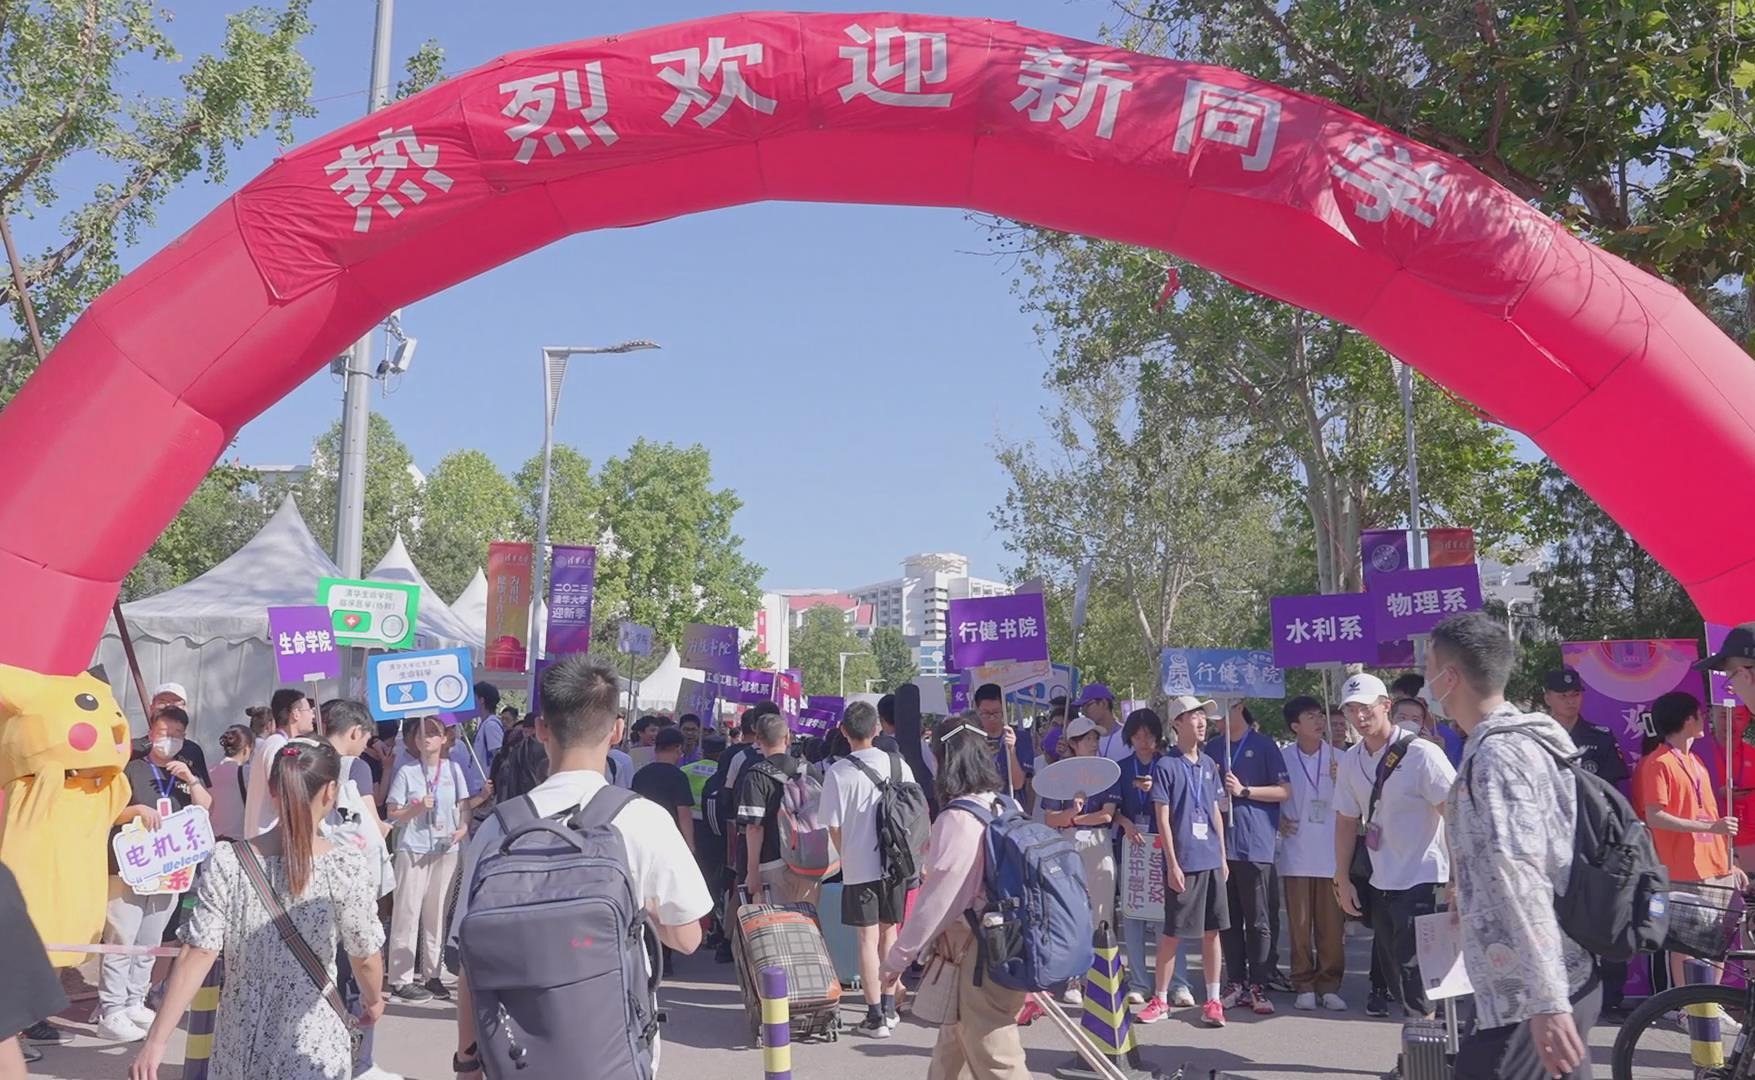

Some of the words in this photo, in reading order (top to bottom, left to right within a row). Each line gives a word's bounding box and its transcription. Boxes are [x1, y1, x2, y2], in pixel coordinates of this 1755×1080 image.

[324, 23, 1451, 233] 热烈欢迎新同学
[552, 607, 587, 620] 迎新季
[1387, 587, 1468, 618] 物理系
[279, 629, 333, 655] 生命学院
[959, 617, 1038, 643] 行健书院
[1286, 615, 1363, 643] 水利系
[126, 818, 205, 868] 电机系
[1127, 842, 1145, 911] 行健书院
